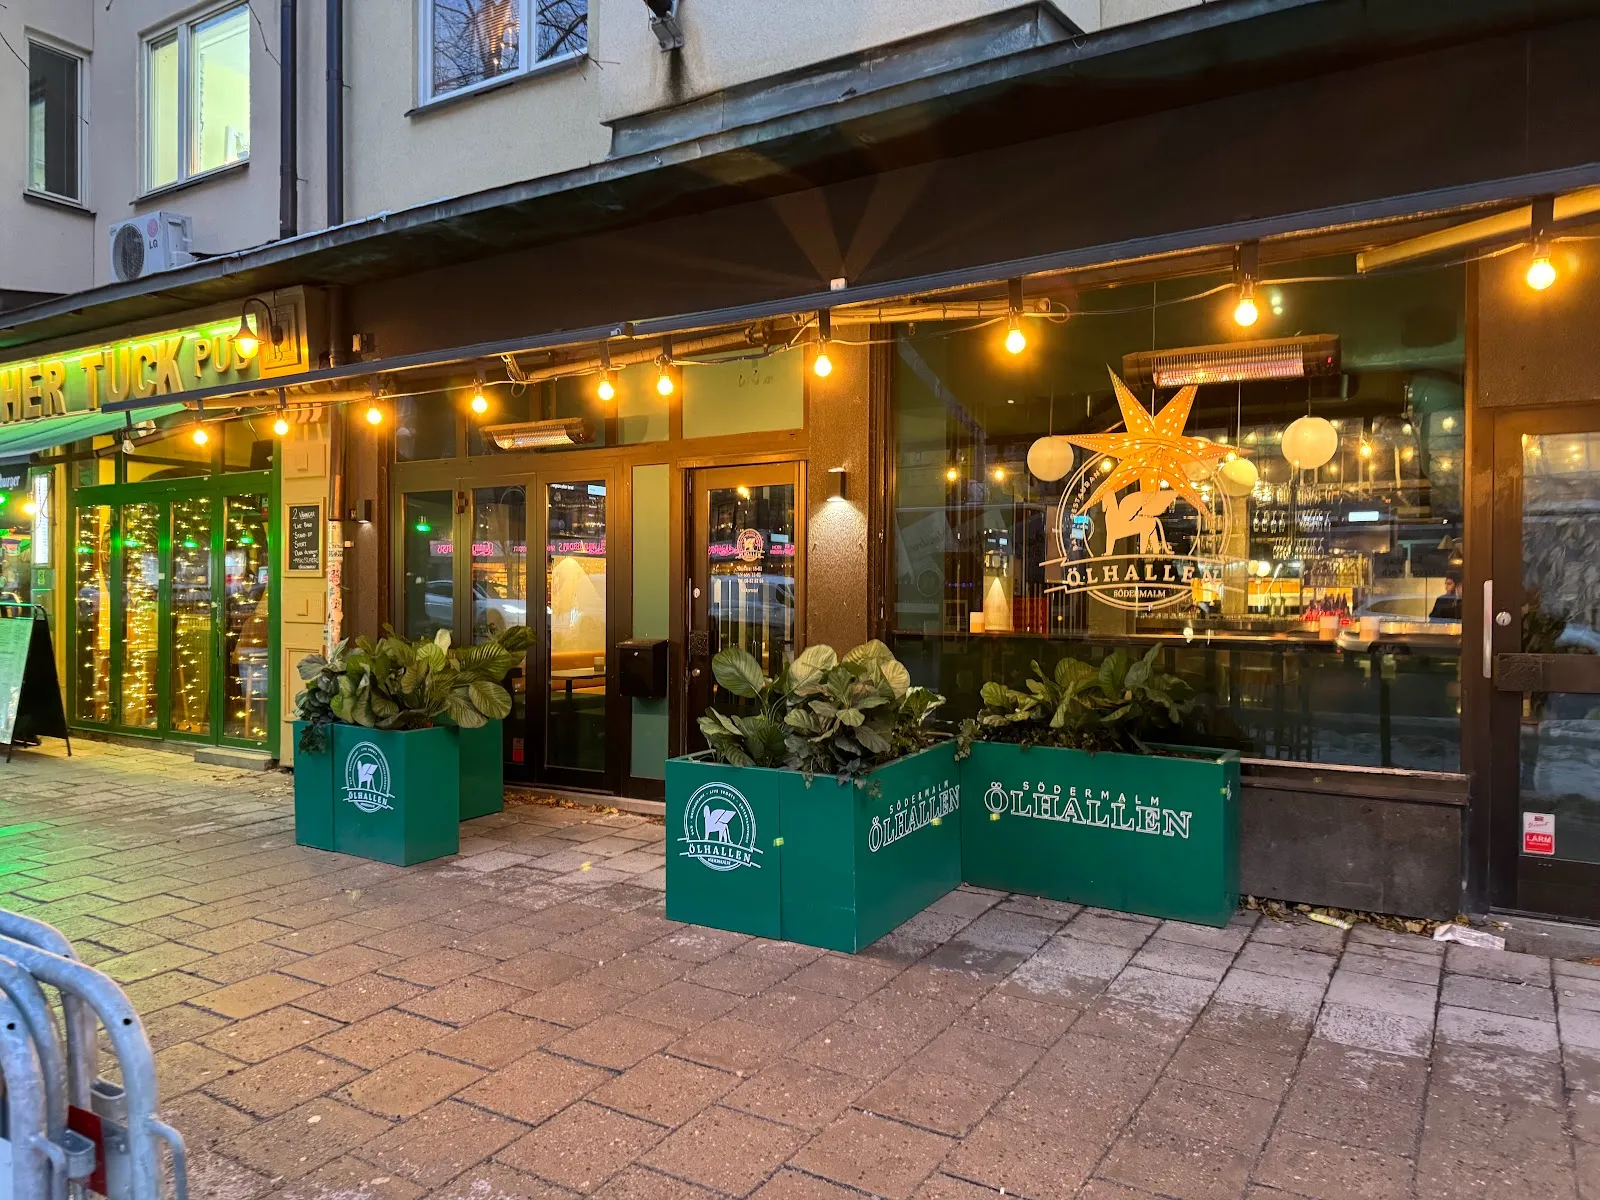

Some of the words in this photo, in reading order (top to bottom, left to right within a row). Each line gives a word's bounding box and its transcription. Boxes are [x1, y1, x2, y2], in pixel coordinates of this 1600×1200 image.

[149, 239, 158, 249] LG
[80, 336, 184, 410] TUCK
[1066, 564, 1222, 587] ÖLHALLEN
[889, 779, 949, 814] SÖDERMALM
[1022, 781, 1159, 806] SÖDERMALM
[868, 784, 960, 852] ÖLHALLEN
[984, 781, 1193, 839] ÖLHALLEN
[1526, 834, 1552, 844] LARM
[688, 843, 751, 862] ÖLHALLEN
